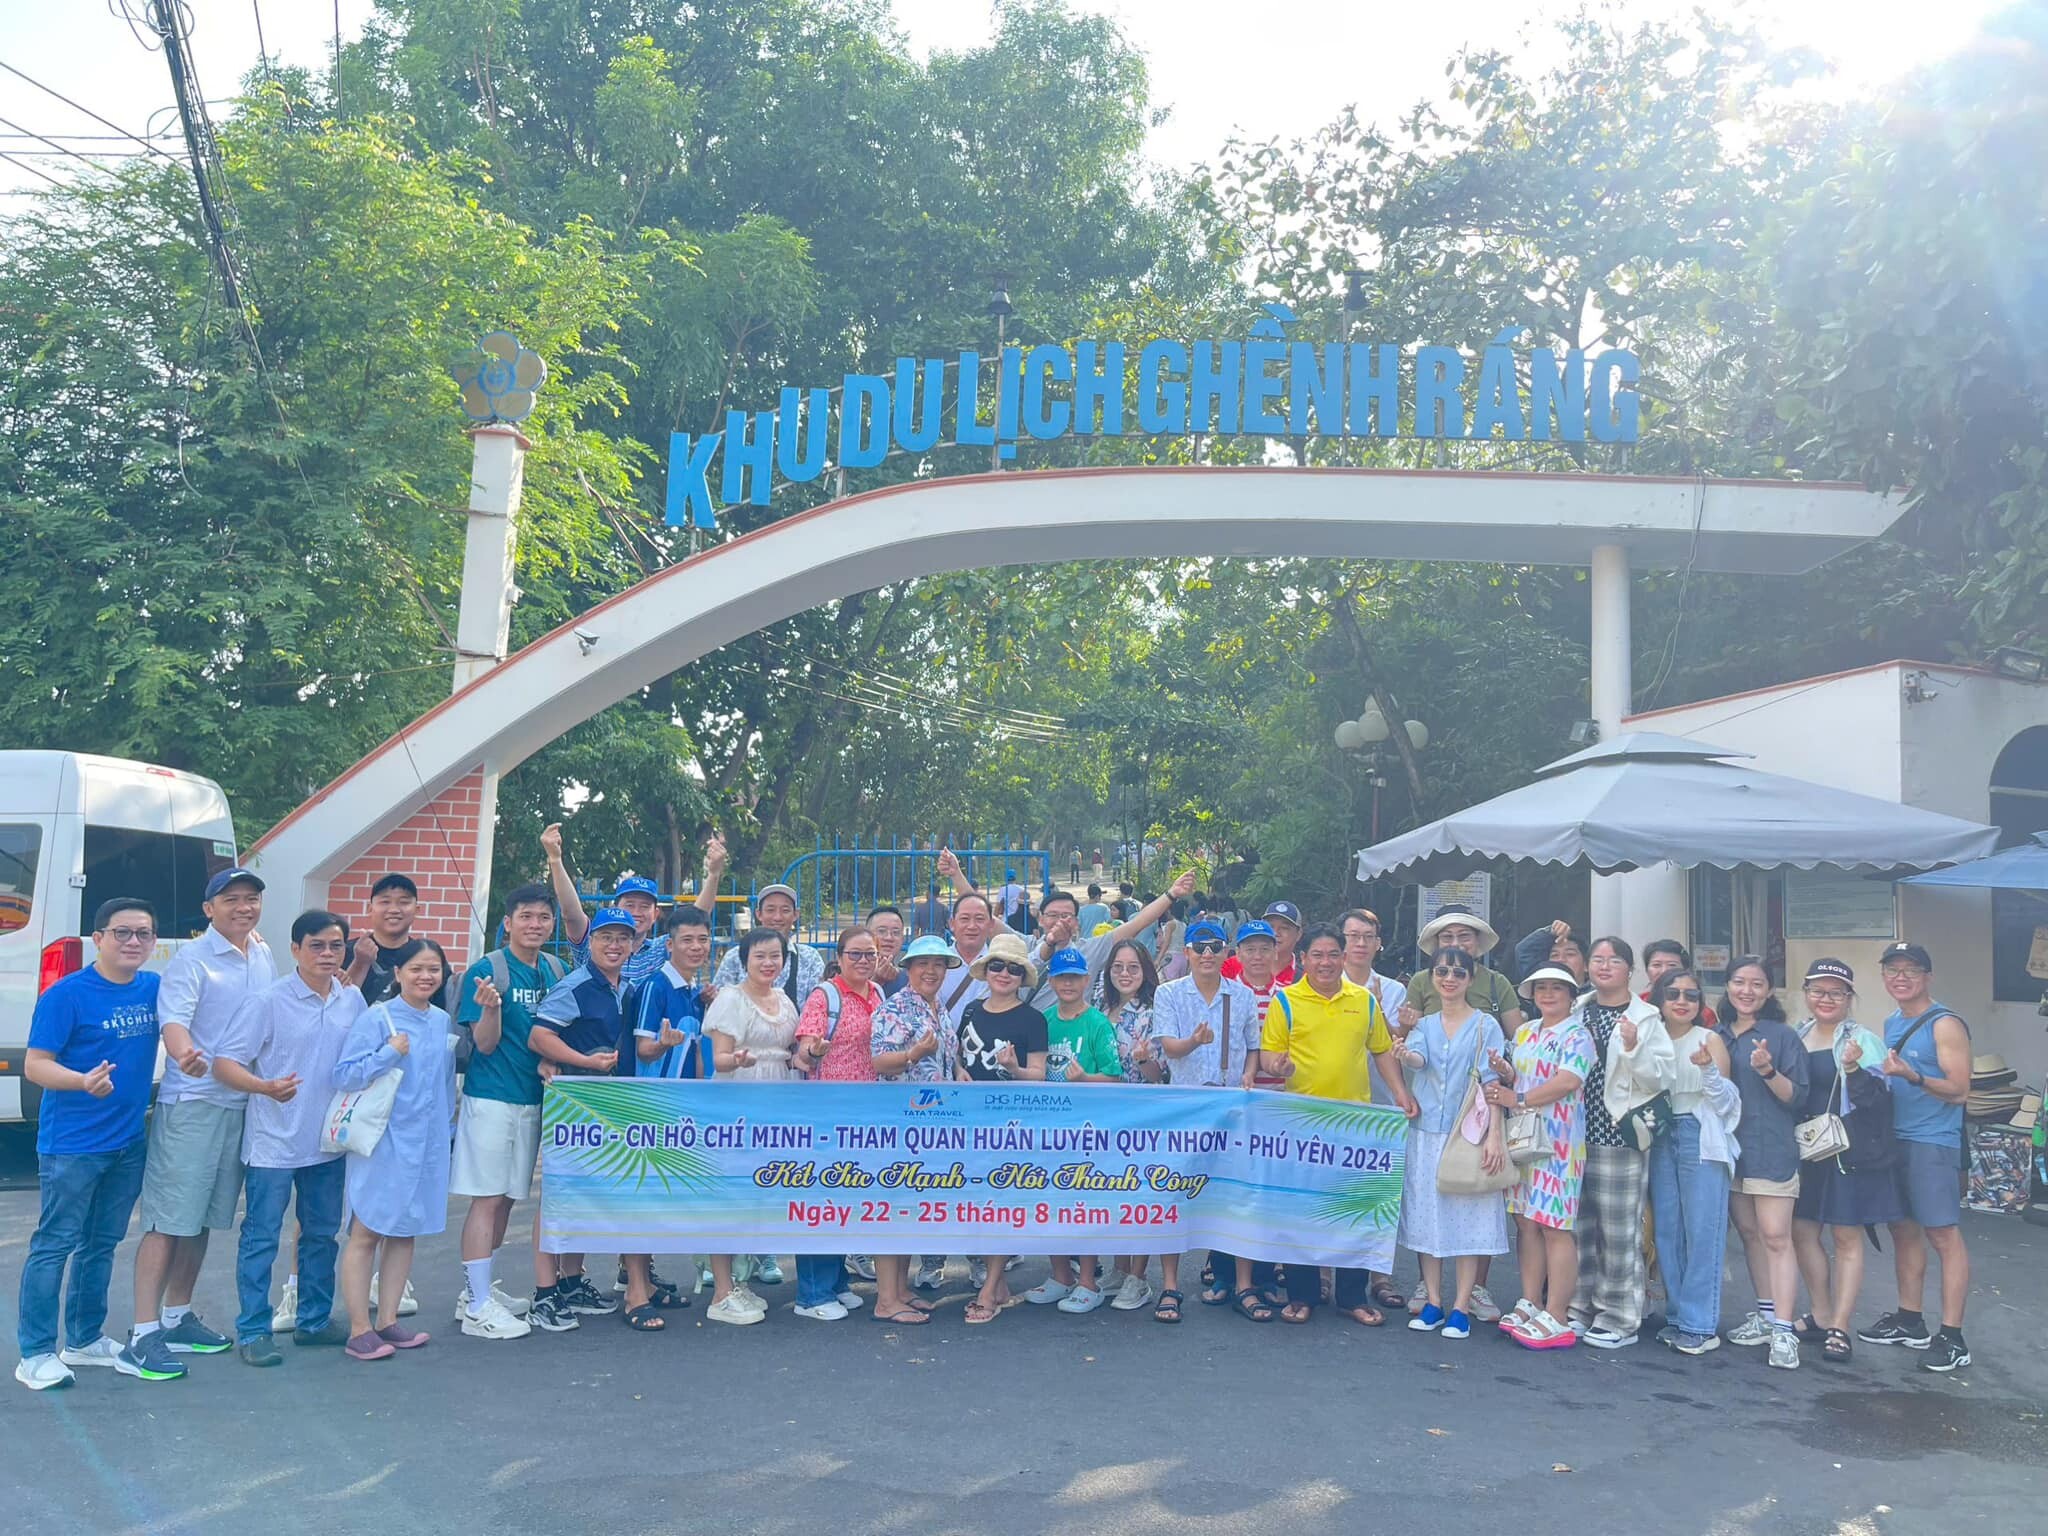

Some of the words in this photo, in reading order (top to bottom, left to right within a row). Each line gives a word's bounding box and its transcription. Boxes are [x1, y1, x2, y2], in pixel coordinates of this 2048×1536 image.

[664, 387, 829, 529] KHU
[839, 357, 944, 468] DU
[956, 340, 1125, 460] LỊCH
[1138, 303, 1400, 437] GHỀNH
[1414, 325, 1641, 444] RÁNG
[984, 1094, 1010, 1105] DHG
[1013, 1094, 1073, 1106] PHARMA
[554, 1123, 602, 1148] DHG
[626, 1124, 656, 1148] CN
[664, 1117, 697, 1148] HỒ
[703, 1117, 745, 1149] CHÍ
[751, 1125, 812, 1149] MINH
[836, 1126, 897, 1149] THAM
[904, 1127, 966, 1155] QUAN
[973, 1120, 1033, 1151] HUẤN
[1041, 1121, 1109, 1157] LUYỆN
[1116, 1129, 1160, 1157] QUY
[1168, 1130, 1228, 1153] NHƠN
[1249, 1130, 1289, 1160] PHÚ
[1296, 1134, 1335, 1166] YÊN
[1341, 1145, 1392, 1173] 2024
[754, 1161, 816, 1189] Kết
[819, 1161, 874, 1189] Sức
[877, 1161, 967, 1193] Mạnh
[987, 1162, 1049, 1190] Nối
[1052, 1162, 1142, 1192] Thành
[1145, 1164, 1210, 1200] Công
[788, 1200, 852, 1227] Ngày
[860, 1201, 890, 1222] 22
[918, 1202, 948, 1222] 25
[956, 1200, 1026, 1228] tháng
[1034, 1203, 1050, 1224] 8
[1057, 1202, 1110, 1225] năm
[1119, 1204, 1179, 1225] 2024
